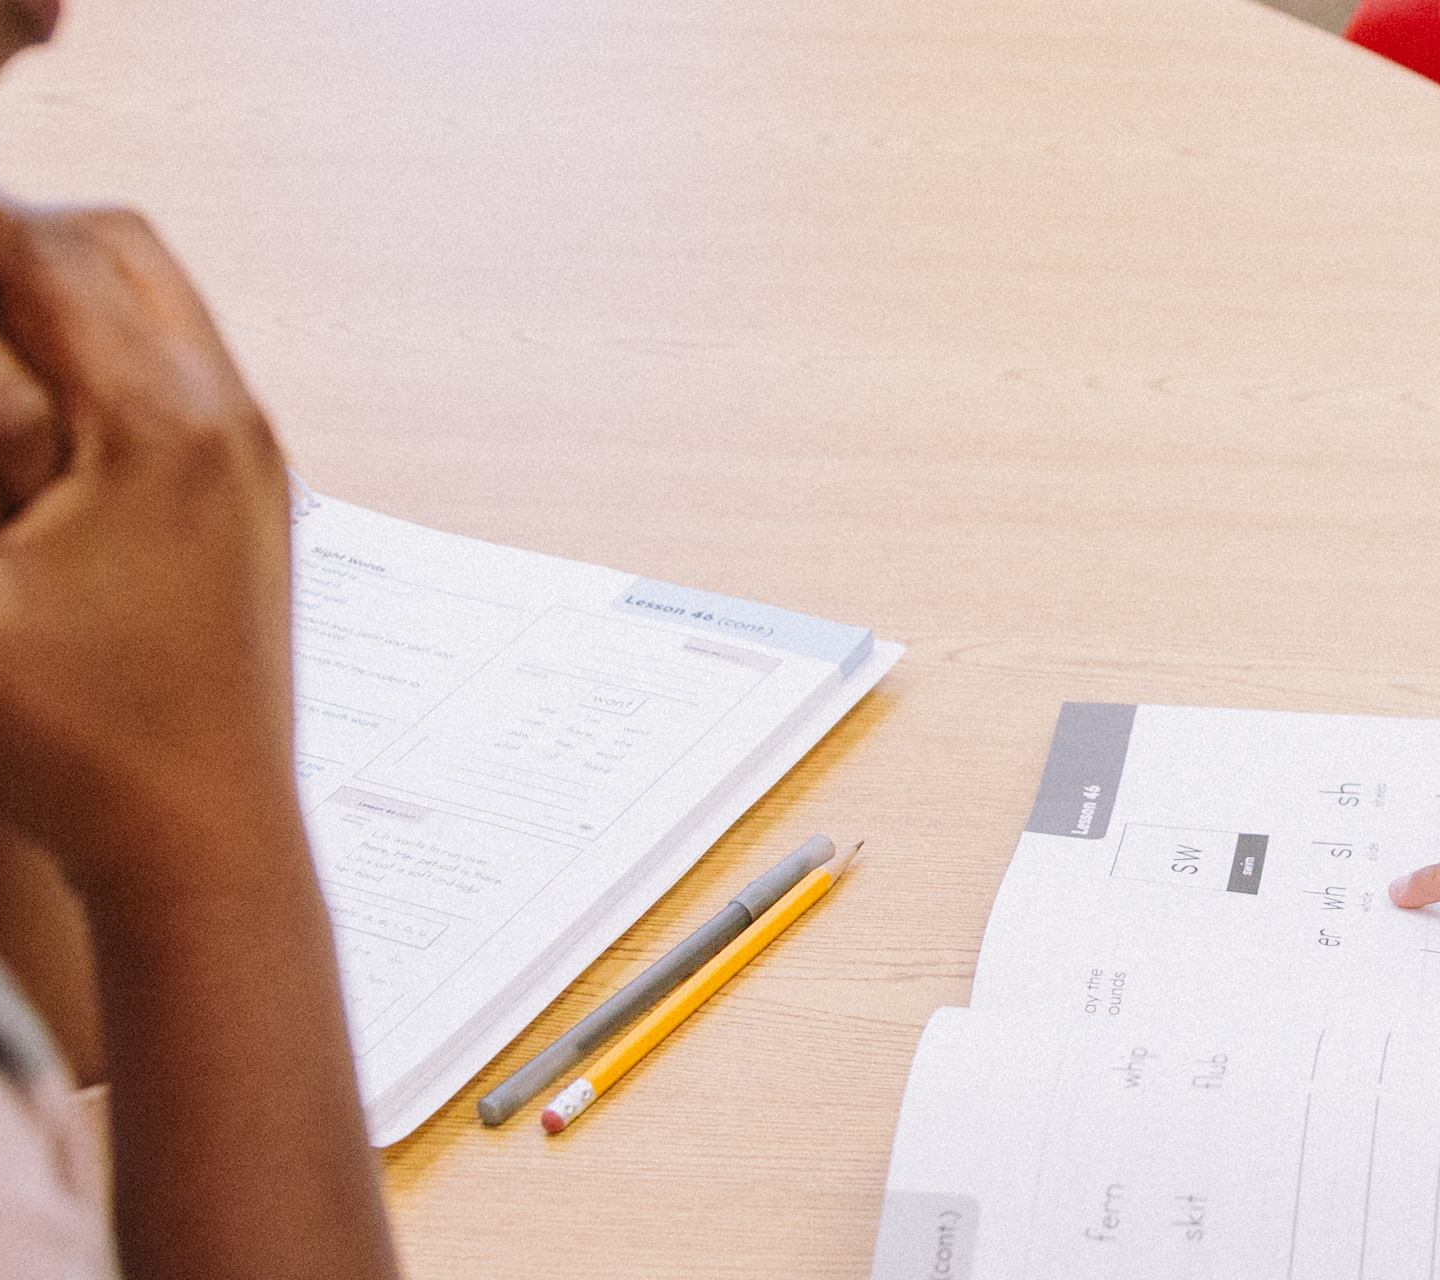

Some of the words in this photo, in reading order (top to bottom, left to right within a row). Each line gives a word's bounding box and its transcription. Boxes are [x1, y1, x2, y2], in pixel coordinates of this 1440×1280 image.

[312, 547, 346, 561] Sight
[348, 557, 386, 572] Words
[625, 595, 686, 616] Lesson
[691, 610, 714, 622] 46
[717, 617, 775, 638] (cont.)
[593, 696, 636, 709] want
[322, 710, 348, 721] each
[1083, 785, 1101, 800] 46
[1318, 782, 1361, 807] sh
[1071, 801, 1096, 835] Lesson
[393, 849, 416, 861] Her
[416, 858, 439, 868] pet
[439, 861, 461, 872] cat
[394, 837, 425, 850] wants
[442, 849, 462, 859] run
[464, 856, 490, 866] over
[1171, 844, 1202, 874] sw
[1311, 841, 1354, 859] sl
[375, 861, 396, 871] cat
[408, 870, 433, 880] soft
[432, 875, 457, 887] and
[1303, 886, 1347, 910] wh
[1318, 928, 1341, 947] er
[1087, 968, 1103, 991] the
[1085, 994, 1103, 1014] ay
[1108, 970, 1127, 1016] ounds
[1112, 1047, 1159, 1089] whip
[1192, 1054, 1229, 1089] flub
[1084, 1183, 1124, 1241] fern
[1172, 1194, 1208, 1241] skit
